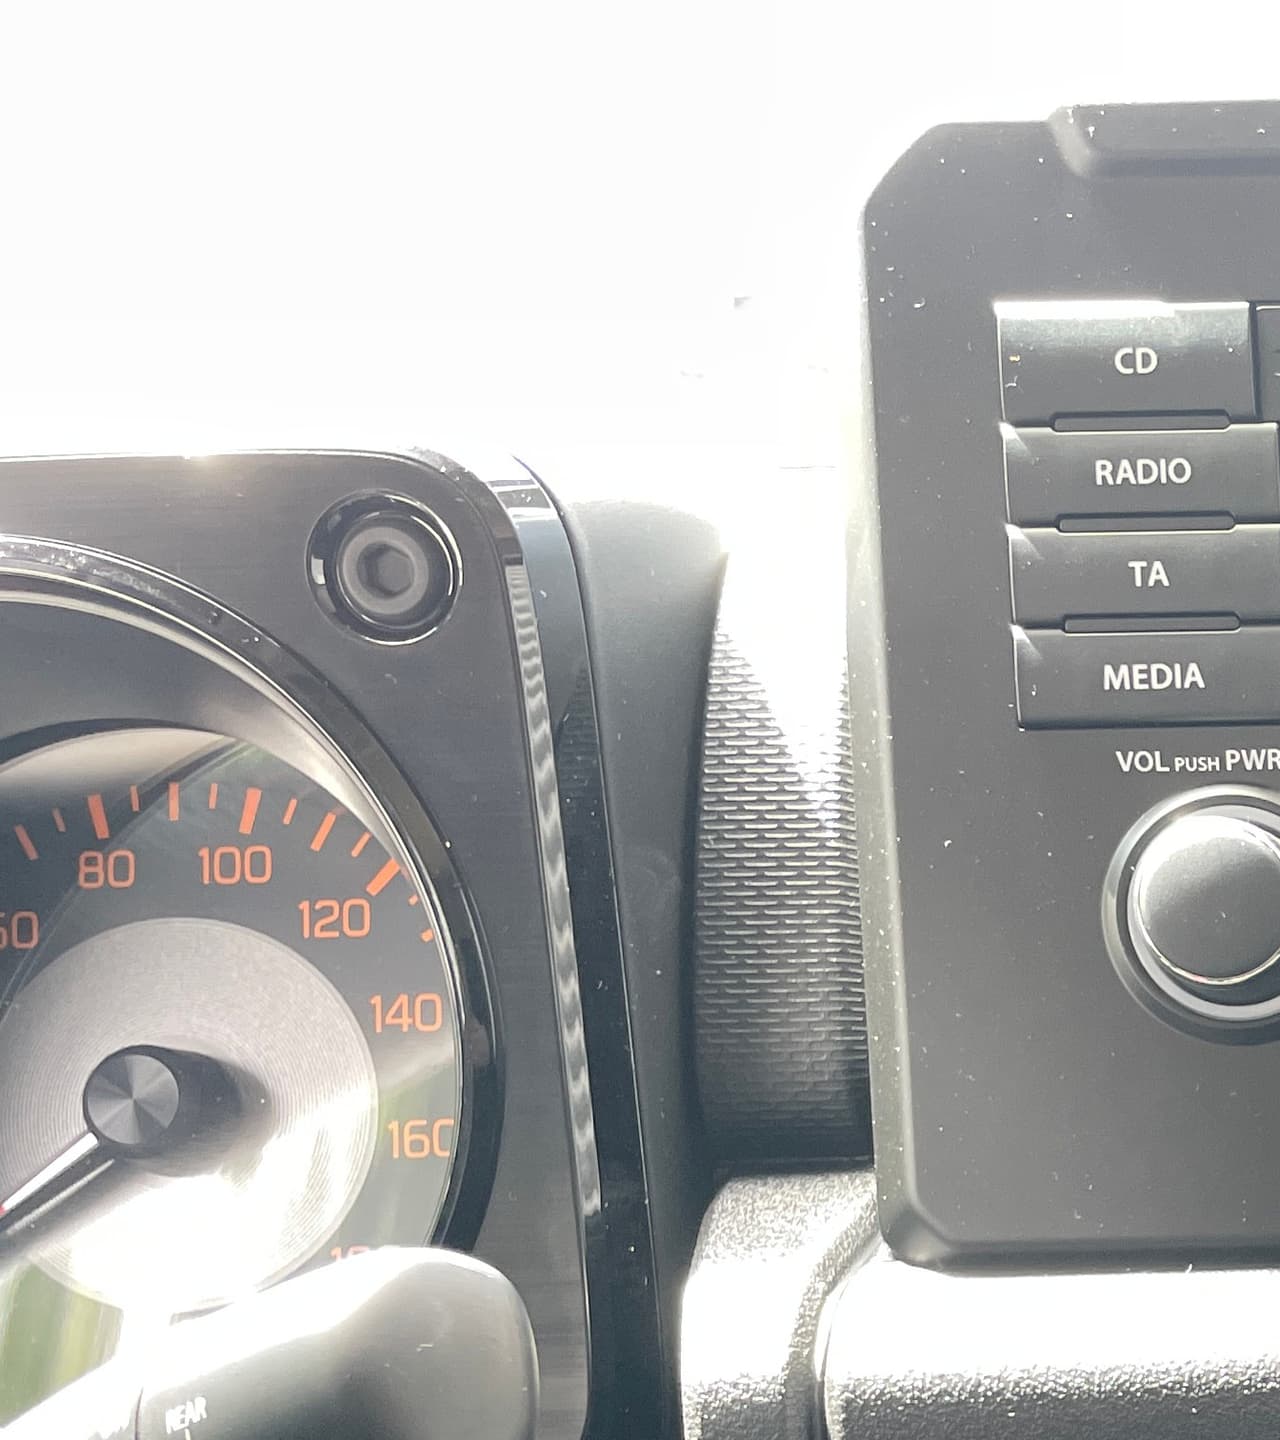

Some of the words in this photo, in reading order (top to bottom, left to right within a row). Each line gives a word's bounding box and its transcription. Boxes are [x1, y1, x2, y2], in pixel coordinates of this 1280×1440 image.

[1114, 347, 1158, 375] CD
[1095, 457, 1192, 486] RADIO
[1128, 560, 1170, 588] TA
[1103, 662, 1205, 691] MEDIA
[1115, 749, 1171, 774] VOL
[1173, 755, 1221, 773] PUSH
[77, 849, 136, 890] 80
[198, 845, 273, 885] 100
[298, 899, 372, 939] 120
[369, 992, 443, 1033] 140
[165, 1396, 207, 1435] REAR
